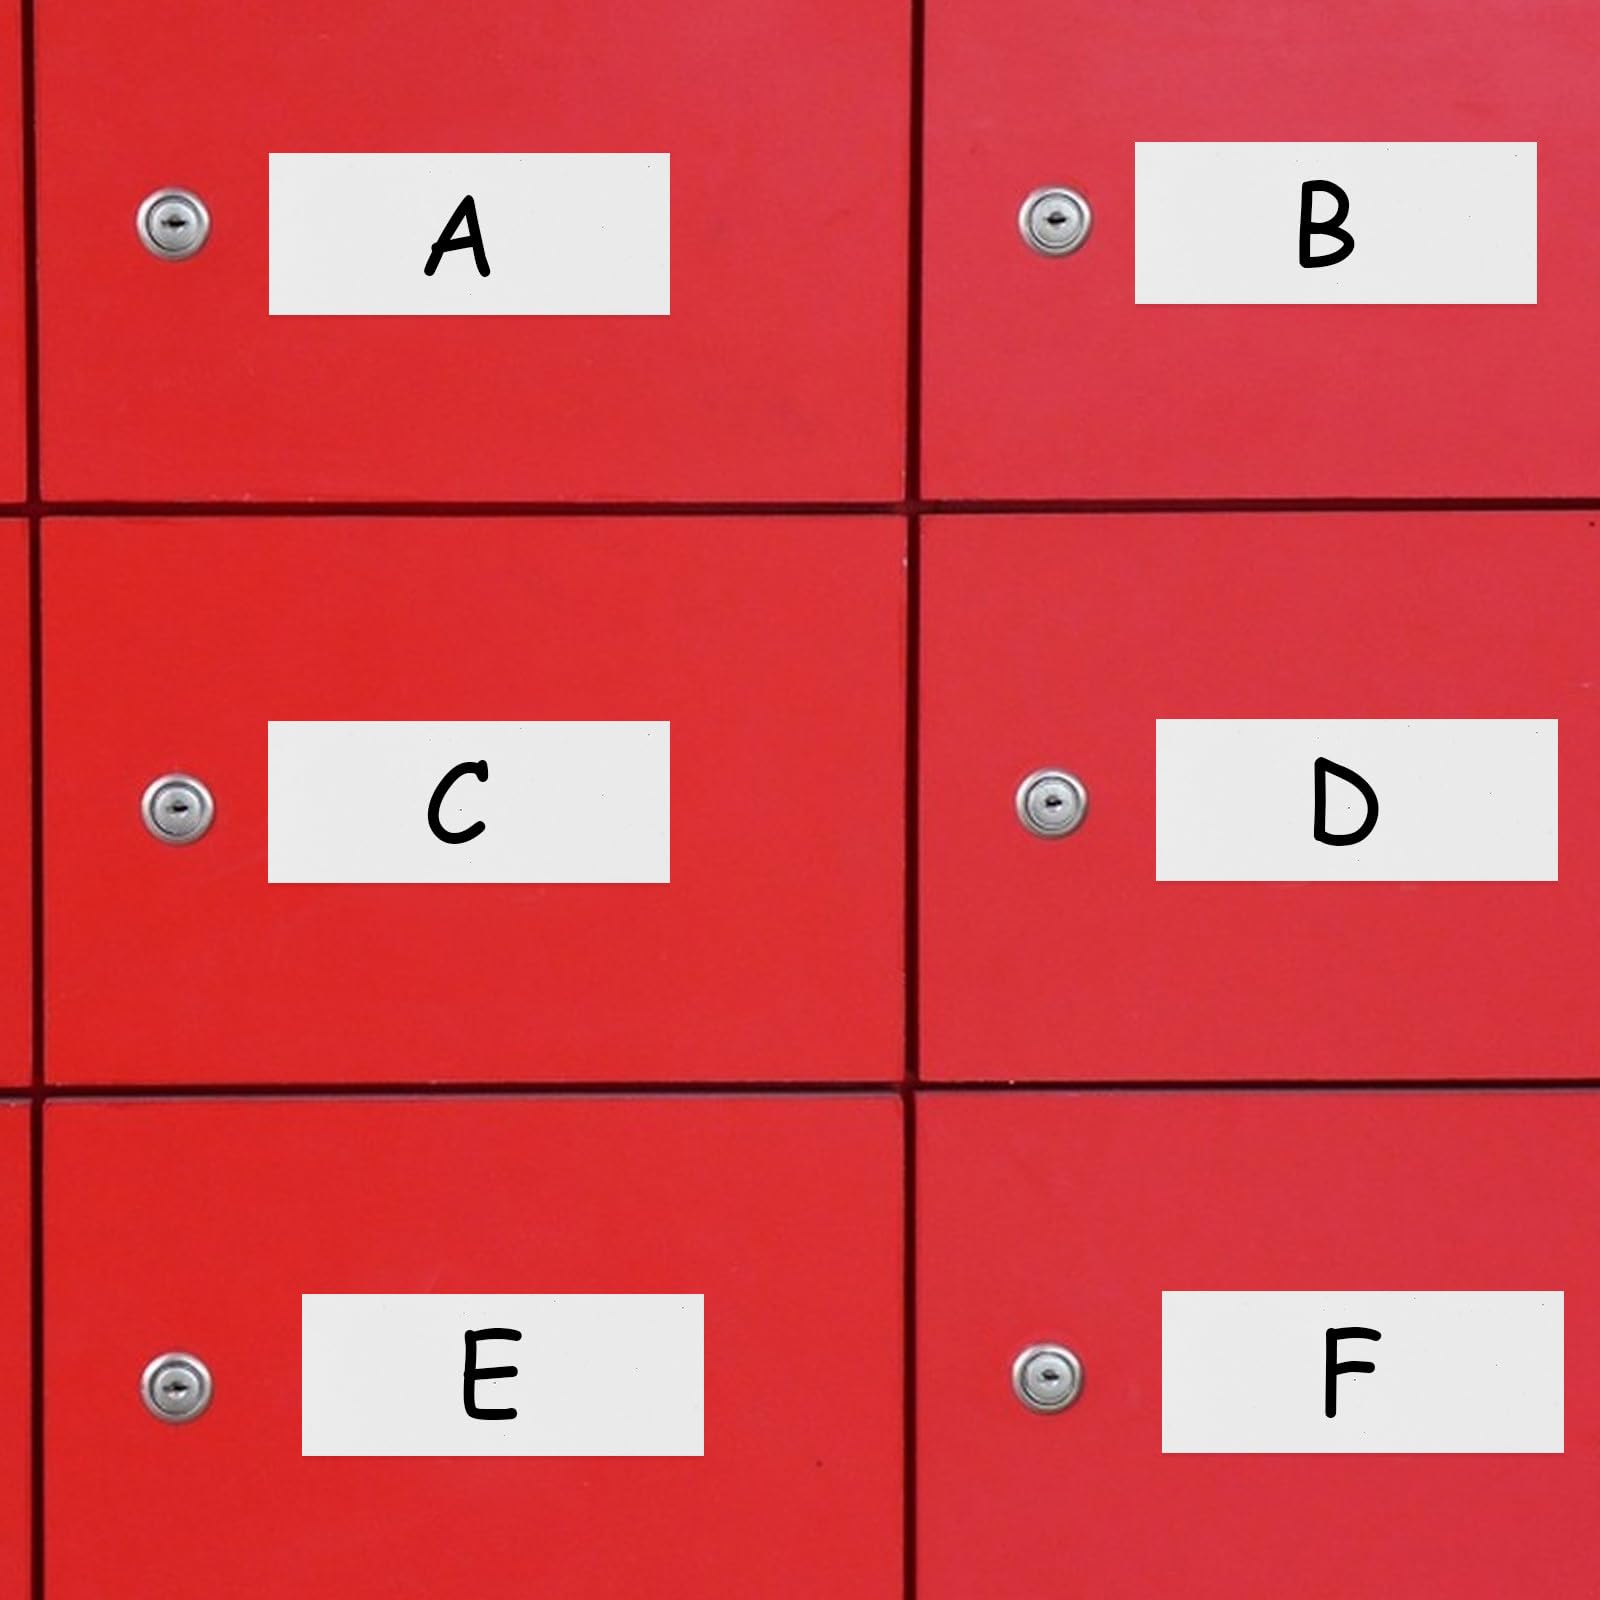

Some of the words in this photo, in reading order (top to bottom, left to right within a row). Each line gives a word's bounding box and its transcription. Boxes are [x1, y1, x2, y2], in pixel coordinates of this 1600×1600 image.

[424, 195, 490, 277] A
[1299, 180, 1354, 268] B
[428, 760, 488, 844] C
[1314, 757, 1378, 846] D
[464, 1328, 522, 1420] E
[1325, 1327, 1381, 1418] F
